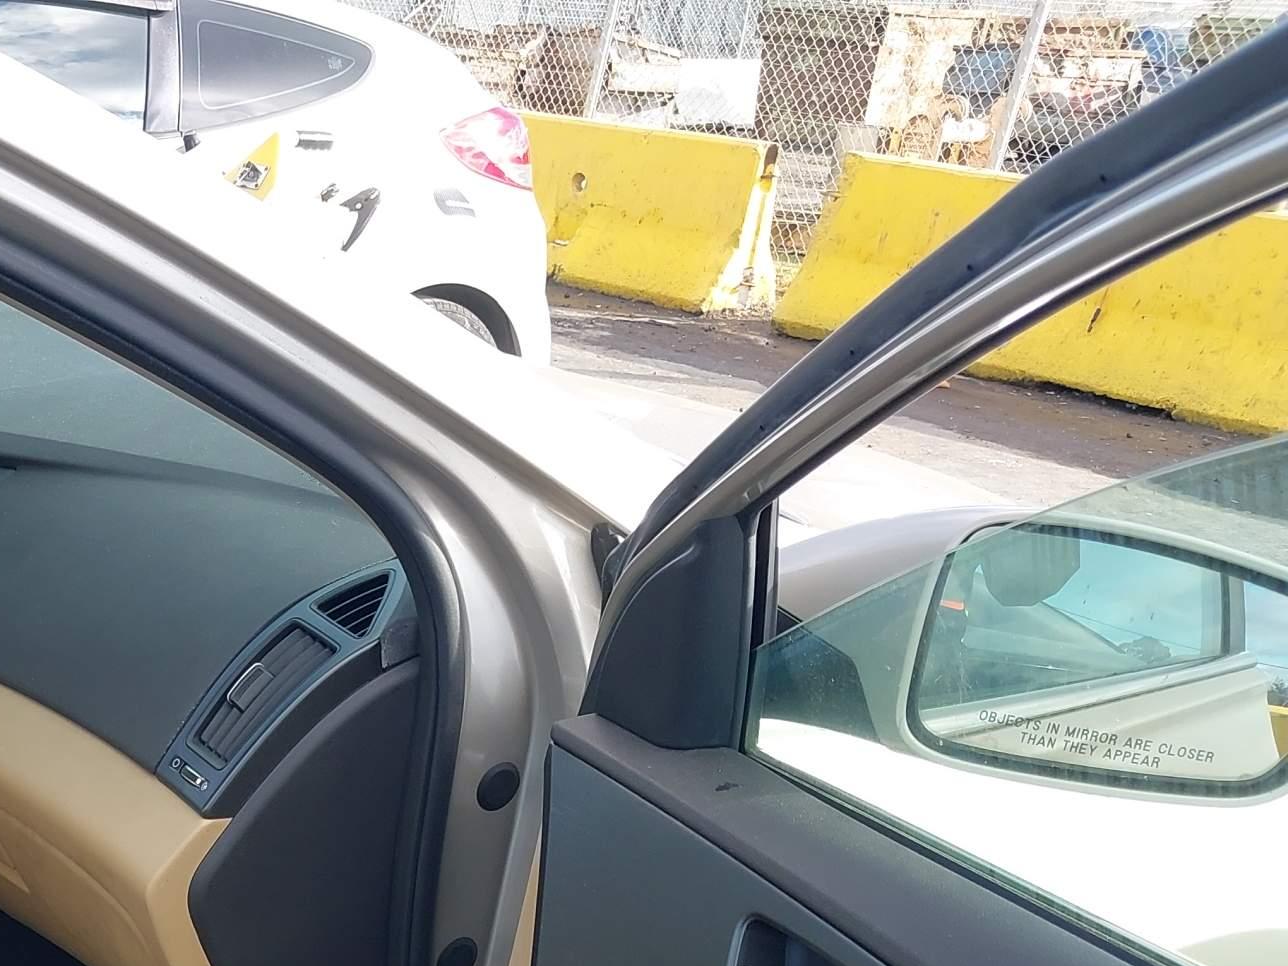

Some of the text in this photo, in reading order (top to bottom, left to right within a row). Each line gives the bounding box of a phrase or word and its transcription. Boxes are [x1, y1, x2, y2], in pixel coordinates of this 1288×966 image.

[979, 710, 1215, 763] OBJECTS IN MIRROR ARE CLOSER
[1020, 731, 1161, 769] THAN THEY APPEAR
